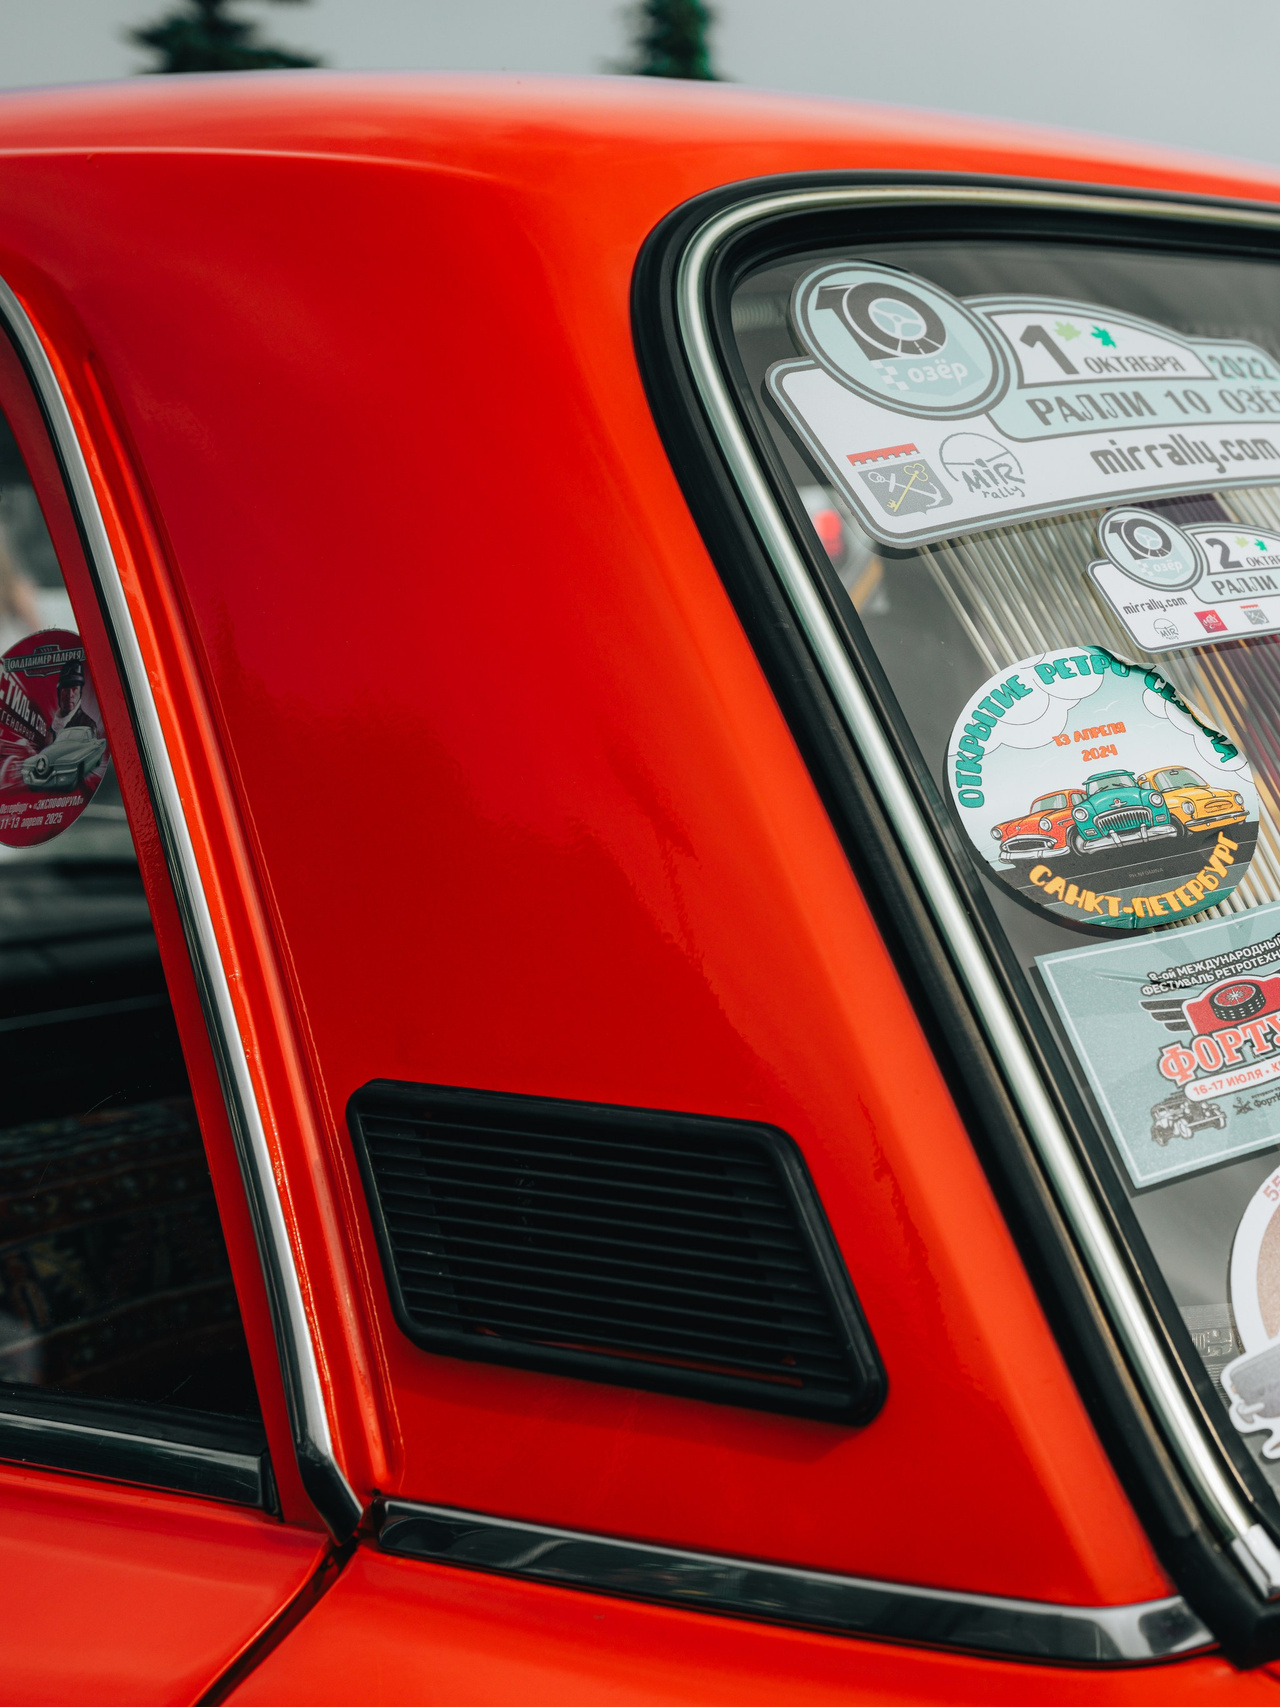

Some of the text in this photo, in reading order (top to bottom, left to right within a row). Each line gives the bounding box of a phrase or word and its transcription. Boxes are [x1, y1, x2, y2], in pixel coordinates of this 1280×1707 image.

[1019, 325, 1187, 375] 1 ОКТЯБРЯ
[907, 359, 968, 386] озёр
[1208, 354, 1278, 381] 2022
[1025, 390, 1157, 426] РАЛЛИ
[1164, 389, 1212, 415] 10
[981, 485, 1026, 500] rally
[1205, 538, 1243, 569] 2
[1153, 560, 1183, 574] озёр
[1211, 574, 1278, 596] РАЛЛИ
[1122, 596, 1188, 615] mirrally.com
[955, 675, 1034, 809] ОТКРЫТИЕ
[1034, 654, 1131, 685] РЕТРО
[1052, 721, 1126, 747] 13 АПРЕЛЯ
[1082, 744, 1118, 762] 2024
[44, 812, 63, 825] 2025
[1029, 831, 1239, 918] САНКТ-ПЕТЕРБУРГ
[1142, 974, 1215, 995] ФЕСТИВАЛЬ
[1193, 1081, 1225, 1097] 16-17
[1226, 1067, 1264, 1088] ИЮЛЯ
